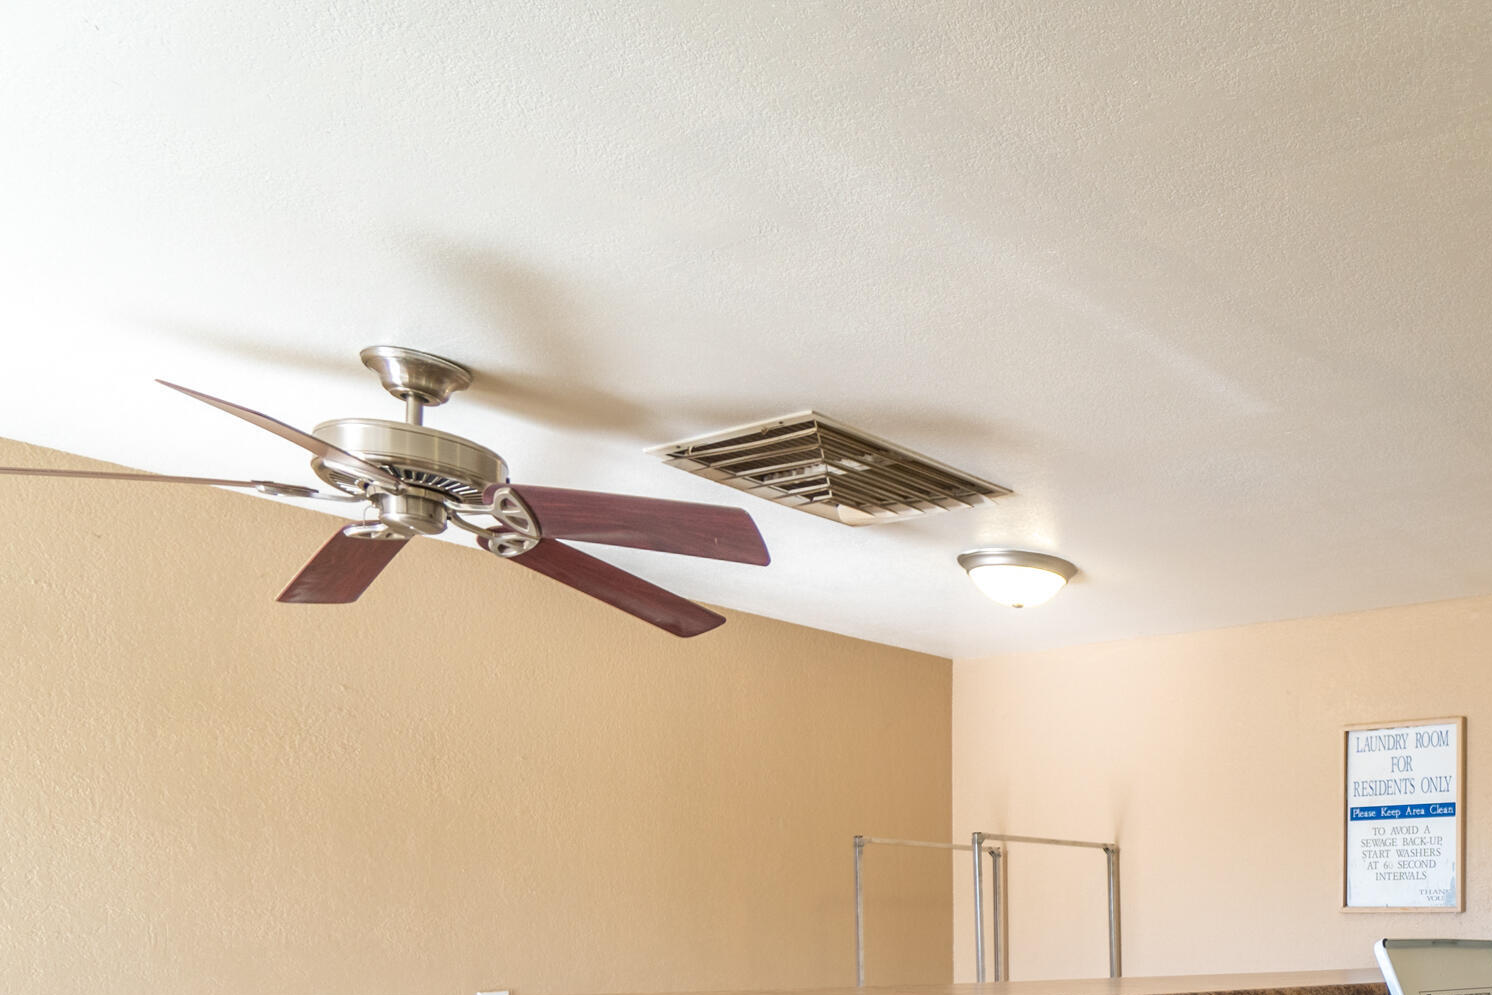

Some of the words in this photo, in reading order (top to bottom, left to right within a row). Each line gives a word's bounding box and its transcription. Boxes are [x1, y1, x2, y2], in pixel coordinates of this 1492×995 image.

[1356, 733, 1408, 753] LAUNDRY
[1415, 730, 1449, 749] ROOM
[1391, 755, 1413, 773] FOR
[1353, 777, 1415, 797] RESIDENTS
[1421, 776, 1452, 793] ONLY
[1353, 808, 1376, 818] Please
[1381, 807, 1401, 818] Keep
[1405, 806, 1424, 815] Area
[1429, 804, 1454, 815] Clean
[1372, 827, 1386, 836] TO
[1390, 825, 1419, 835] AVOID
[1424, 825, 1431, 834] A
[1361, 838, 1398, 848] SEWAGE
[1362, 849, 1391, 859] START
[1396, 848, 1441, 858] WASHERS
[1367, 861, 1379, 870] AT
[1397, 860, 1436, 869] SECOND
[1375, 871, 1427, 881] INTERVALS
